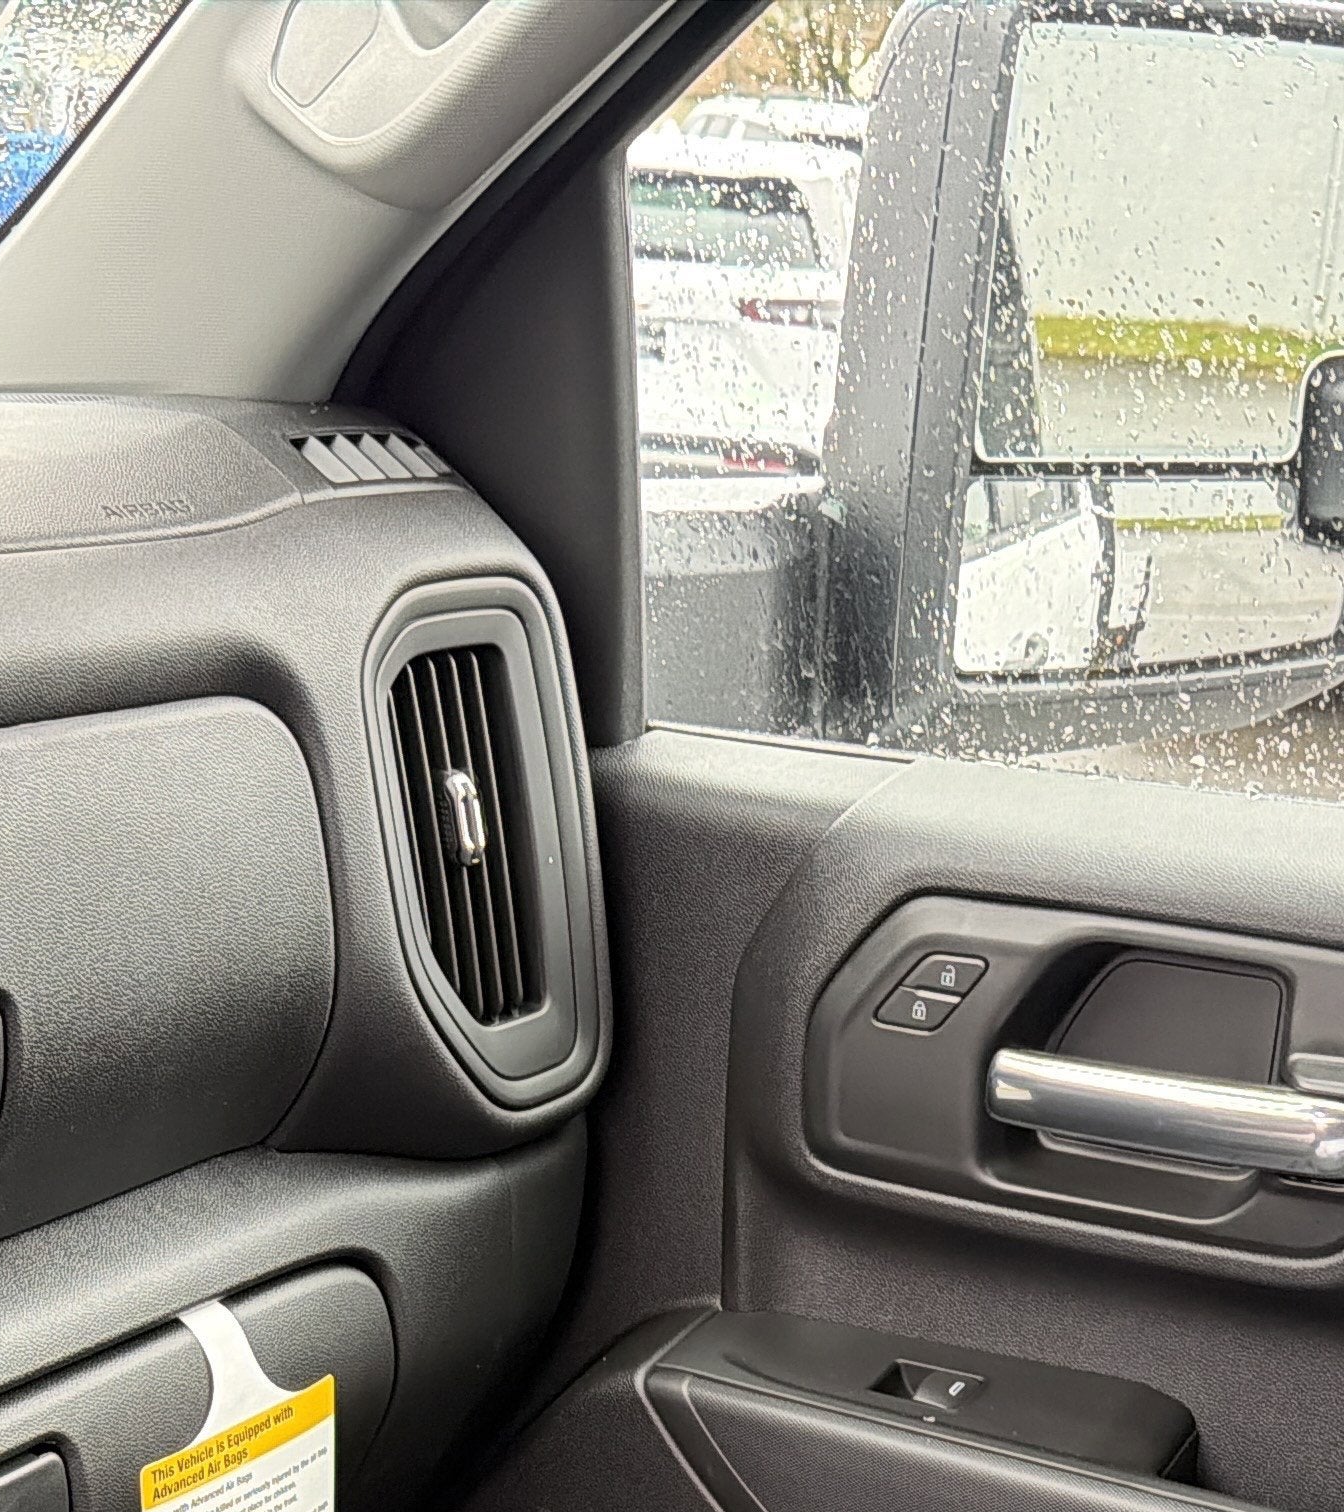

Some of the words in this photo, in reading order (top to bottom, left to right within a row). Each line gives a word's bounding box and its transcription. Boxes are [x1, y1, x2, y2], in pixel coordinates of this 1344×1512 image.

[101, 499, 194, 520] AIRBAG
[151, 1464, 175, 1485] This
[176, 1446, 214, 1472] Vehicle
[216, 1439, 225, 1454] is
[227, 1415, 271, 1449] Equipped
[273, 1405, 294, 1425] with
[153, 1466, 205, 1502] Advanced
[207, 1460, 221, 1477] Air
[224, 1447, 248, 1468] Bags
[191, 1485, 224, 1509] Advanced
[226, 1481, 235, 1492] Air
